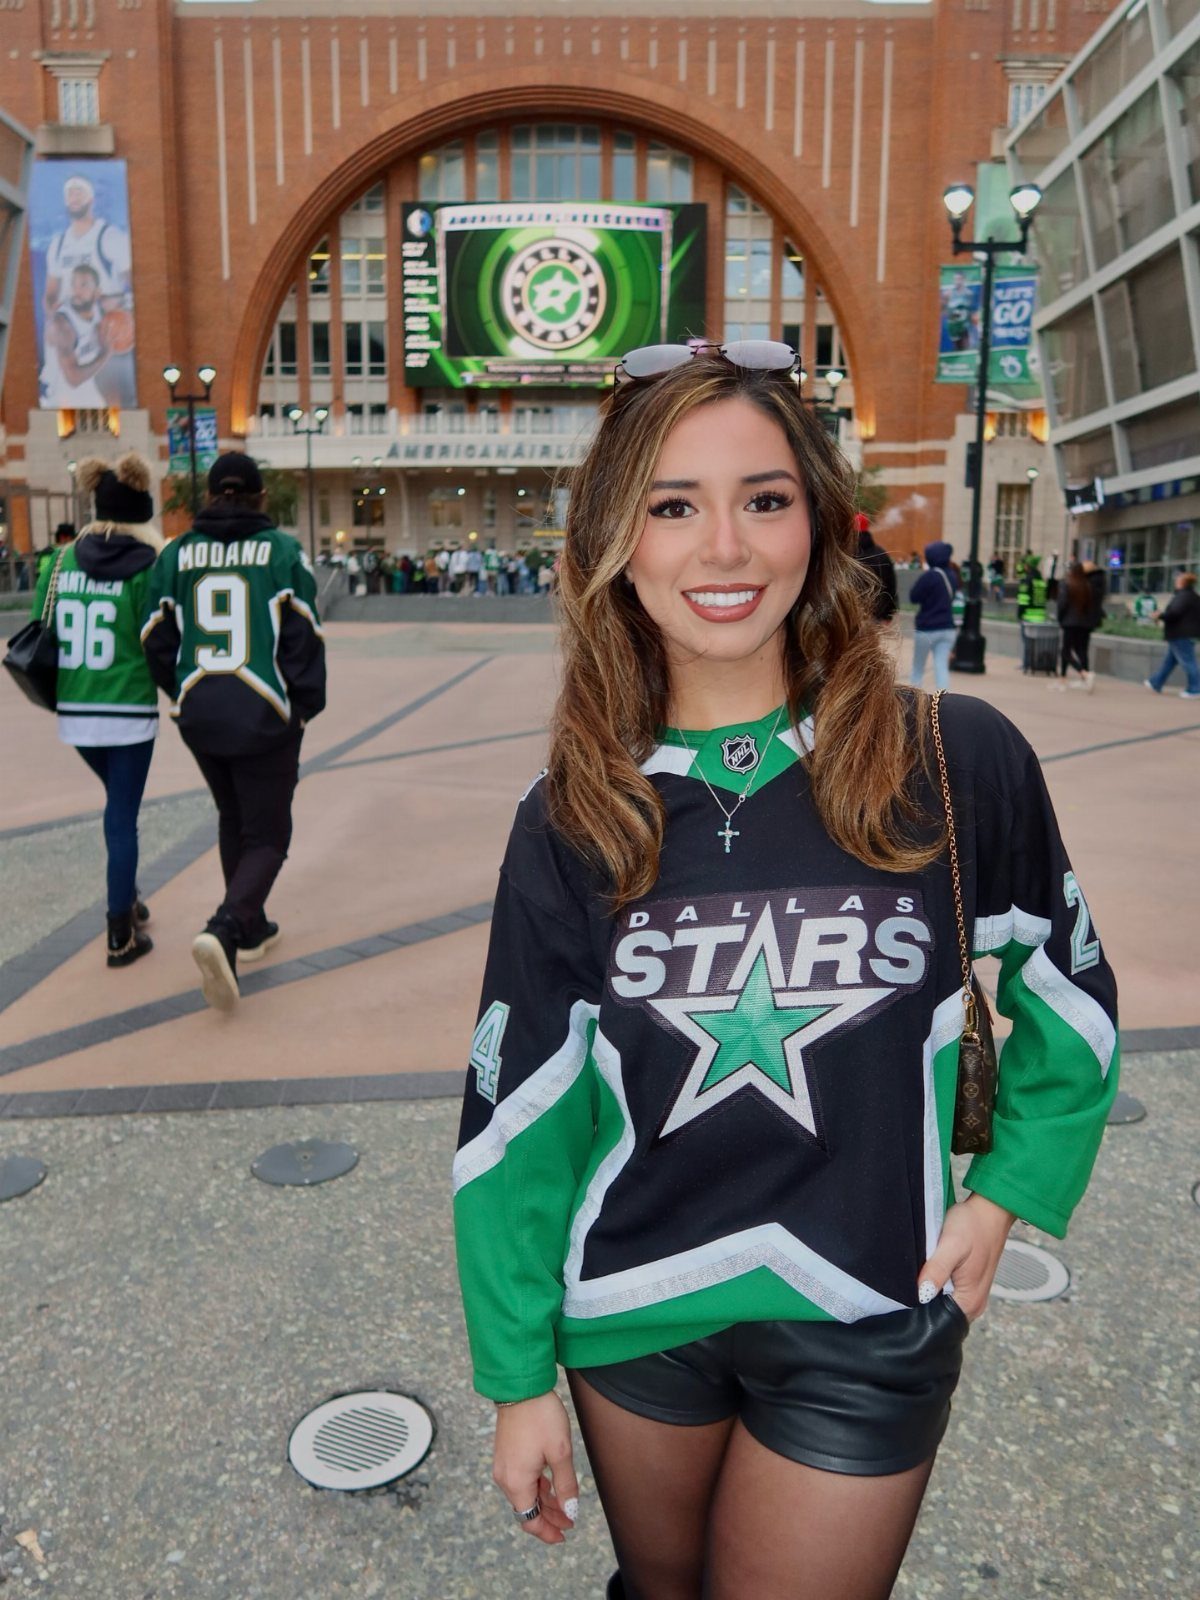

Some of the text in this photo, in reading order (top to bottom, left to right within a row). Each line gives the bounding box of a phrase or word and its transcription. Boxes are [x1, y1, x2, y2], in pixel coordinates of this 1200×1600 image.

[993, 300, 1031, 325] GO
[178, 540, 272, 572] MODANO
[56, 599, 117, 671] 96
[195, 573, 250, 674] 9
[731, 744, 750, 766] NHL
[628, 895, 914, 929] DALLAS
[1063, 870, 1100, 976] 2
[611, 900, 931, 998] STARS
[469, 1000, 511, 1106] 4
